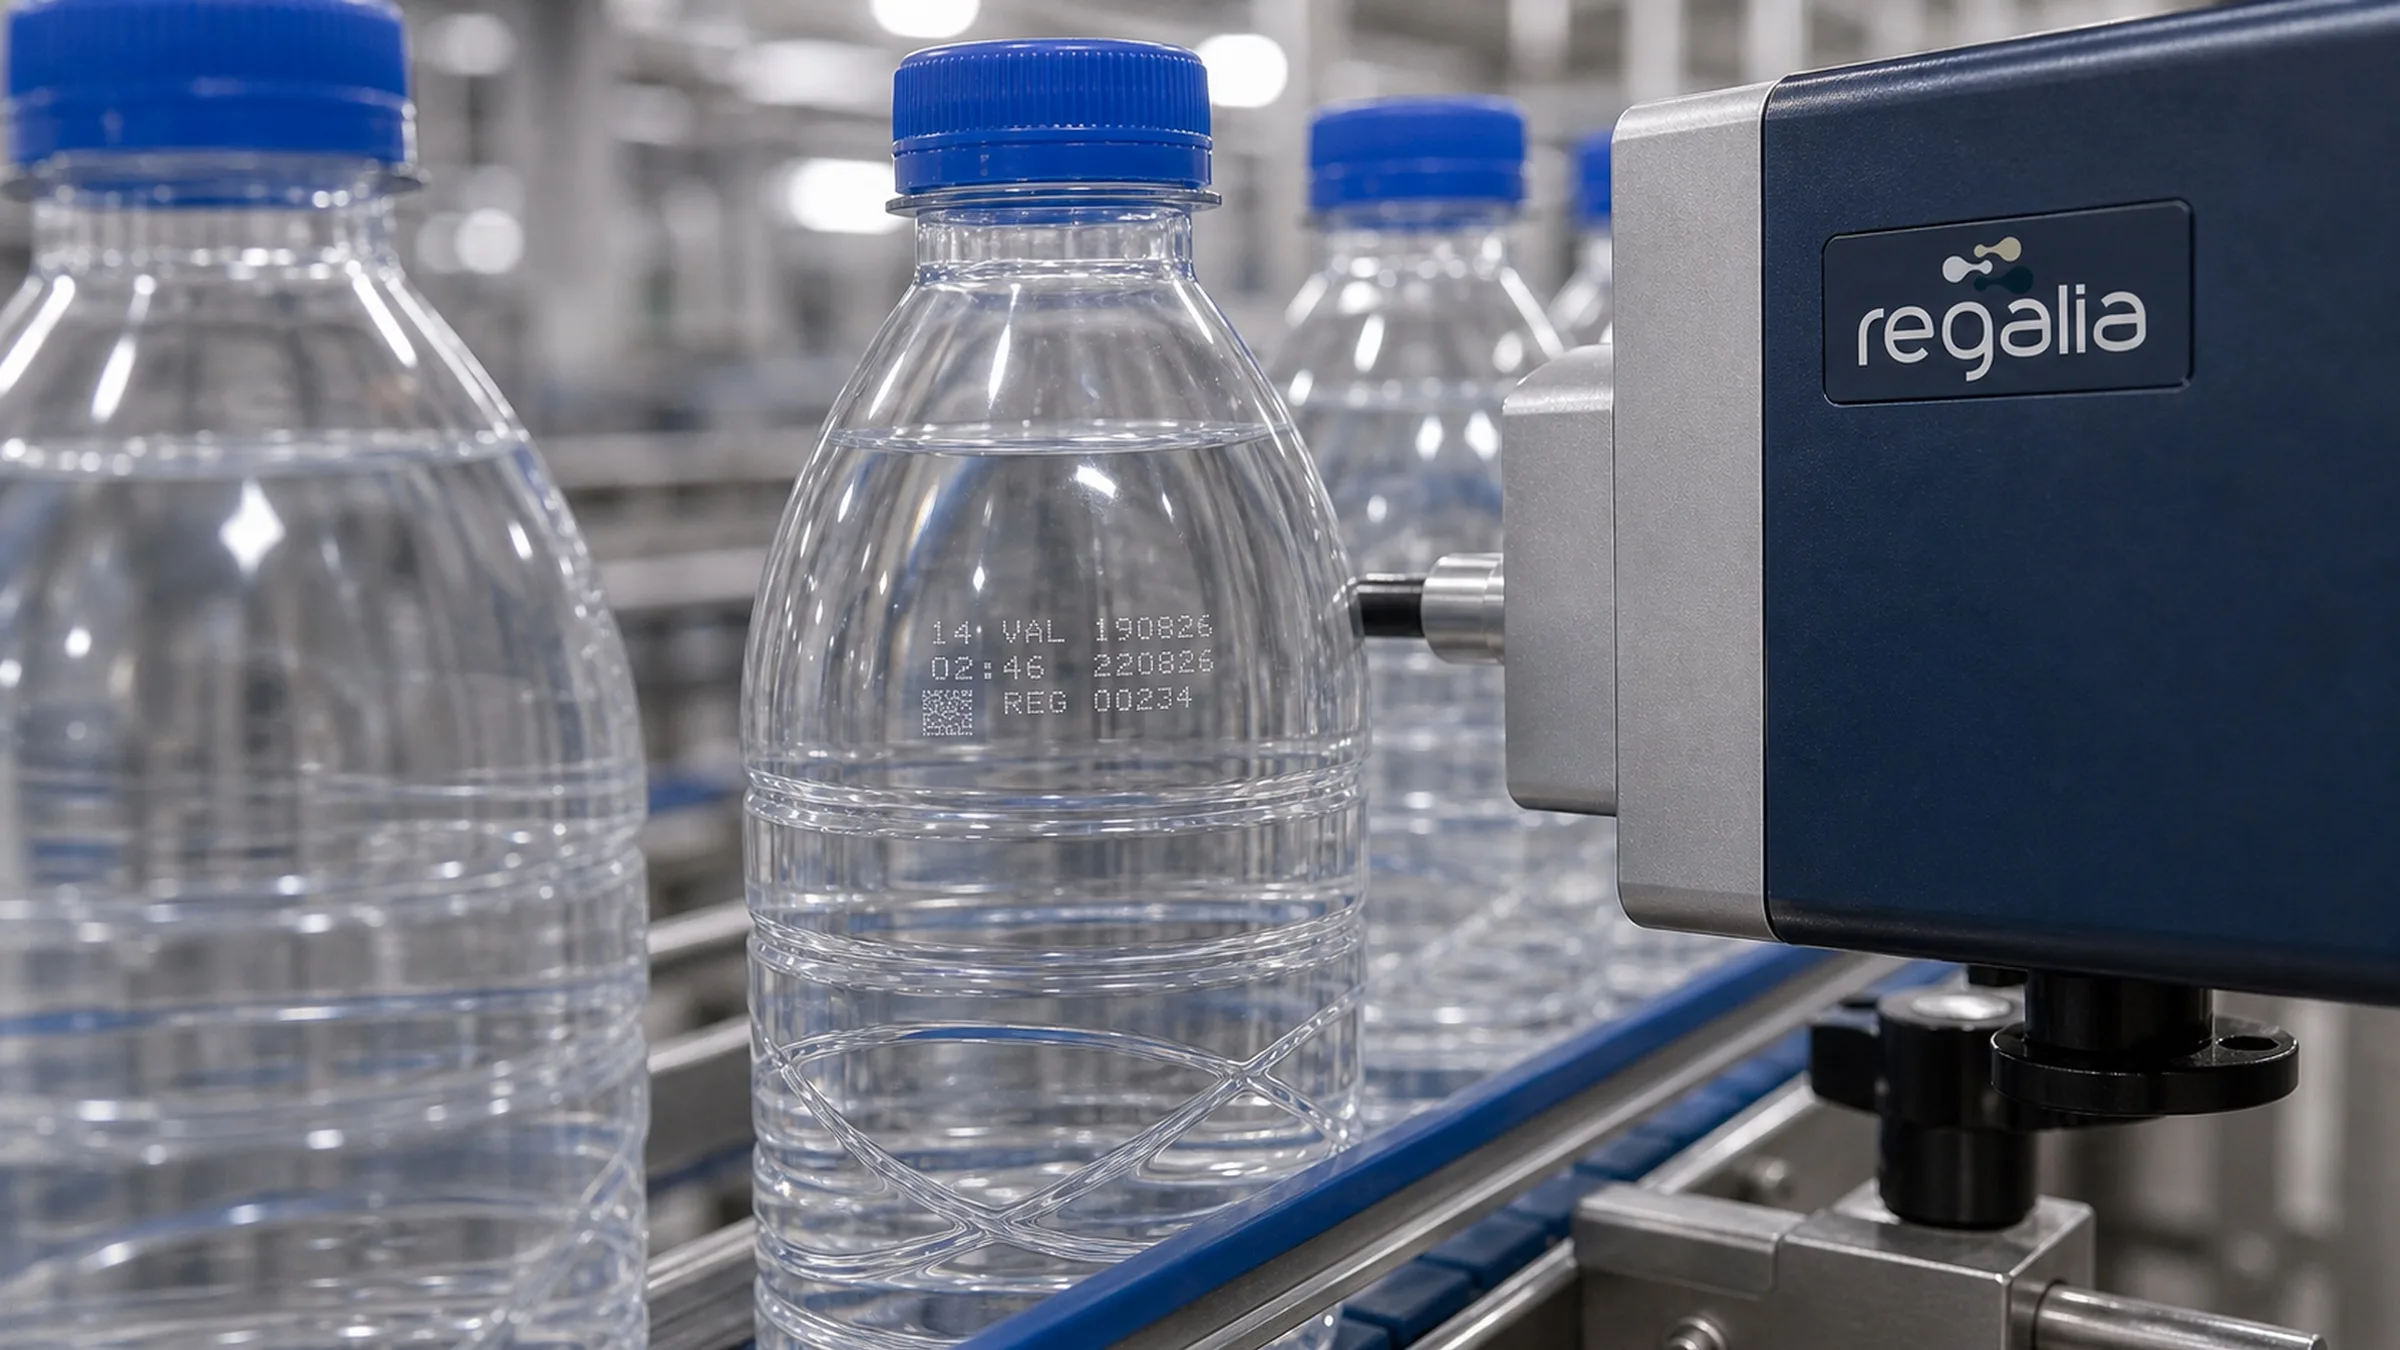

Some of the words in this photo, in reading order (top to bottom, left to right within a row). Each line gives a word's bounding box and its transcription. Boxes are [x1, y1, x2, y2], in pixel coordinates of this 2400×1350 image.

[1858, 283, 2147, 382] regalia
[931, 620, 972, 645] 14
[1002, 619, 1066, 644] VAL
[1095, 614, 1214, 642] 190826
[1093, 649, 1215, 679] 220826
[1003, 690, 1068, 715] REG
[1093, 685, 1193, 713] 00234
